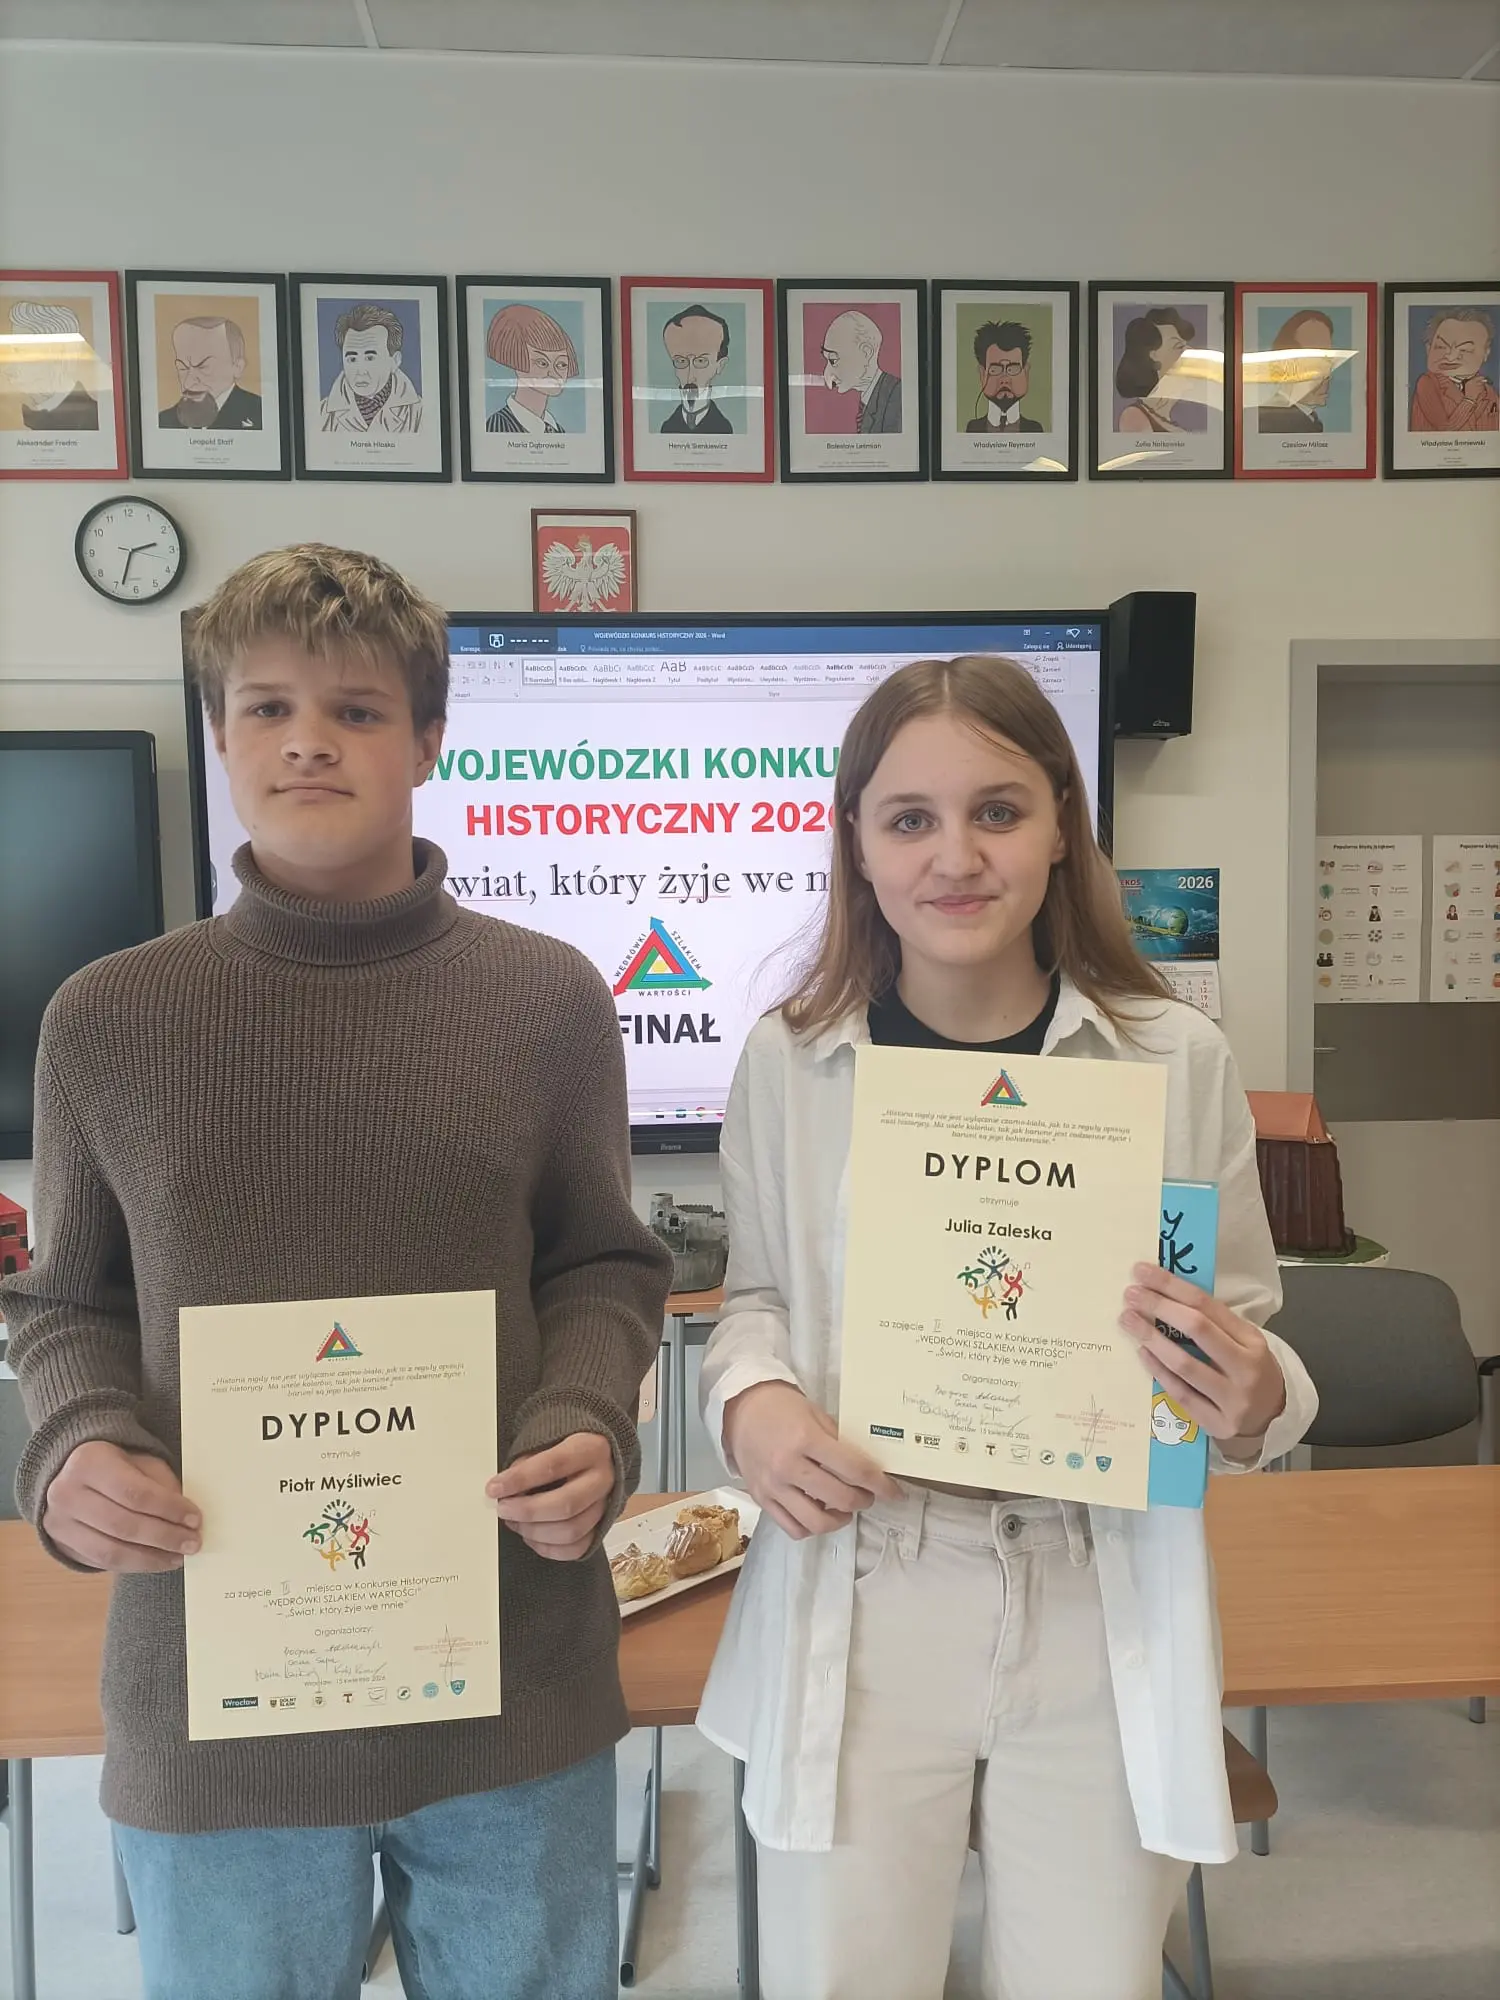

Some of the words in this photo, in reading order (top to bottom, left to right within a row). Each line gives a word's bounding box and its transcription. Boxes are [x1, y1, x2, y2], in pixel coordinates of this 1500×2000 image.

[189, 438, 216, 447] Leopold
[350, 440, 372, 448] Marek
[507, 440, 528, 449] Maria
[668, 441, 691, 451] Henryk
[692, 441, 728, 450] Sienkiewicz
[1008, 441, 1036, 450] Reymont
[124, 508, 134, 518] 12
[147, 513, 151, 522] 1
[106, 515, 114, 523] 11
[94, 529, 104, 537] 10
[160, 526, 167, 534] 2
[89, 549, 95, 557] 9
[169, 545, 175, 553] 3
[97, 569, 104, 577] 8
[165, 565, 171, 573] 4
[113, 581, 119, 589] 7
[152, 579, 159, 588] 5
[133, 586, 139, 594] 6
[428, 739, 689, 781] WOJEWÓDZKI
[466, 802, 740, 836] HISTORYCZNY
[550, 864, 647, 905] który
[658, 862, 732, 905] żyje
[742, 872, 794, 893] we
[1177, 875, 1214, 889] 2026
[614, 933, 647, 977] WĘDRÓWKI
[671, 930, 702, 970] SZLAKIEM
[638, 989, 691, 997] WARTOŚCI
[618, 1013, 721, 1044] FINAŁ
[925, 1152, 1076, 1189] DYPLOM
[979, 1196, 1020, 1208] otrzymuje
[944, 1218, 983, 1235] Julia
[988, 1222, 1053, 1241] Zaleska
[879, 1320, 890, 1328] za
[892, 1321, 924, 1331] zajęcie
[957, 1328, 992, 1340] miejsca
[1005, 1332, 1048, 1345] Konkursie
[1051, 1338, 1112, 1352] Historycznym
[973, 1341, 1015, 1353] SZLAKIEM
[969, 1352, 991, 1363] który
[993, 1355, 1010, 1366] żyje
[262, 1405, 416, 1441] DYPLOM
[320, 1449, 361, 1461] otrzymuje
[279, 1478, 316, 1494] Piotr
[320, 1472, 402, 1494] Myśliwiec
[306, 1583, 342, 1594] miejsca
[355, 1579, 398, 1590] Konkursie
[400, 1574, 459, 1587] Historycznym
[224, 1590, 236, 1599] za
[323, 1593, 366, 1604] SZLAKIEM
[319, 1605, 342, 1615] który
[344, 1603, 362, 1614] żyje
[364, 1603, 379, 1611] we
[224, 1699, 257, 1708] Wrocław
